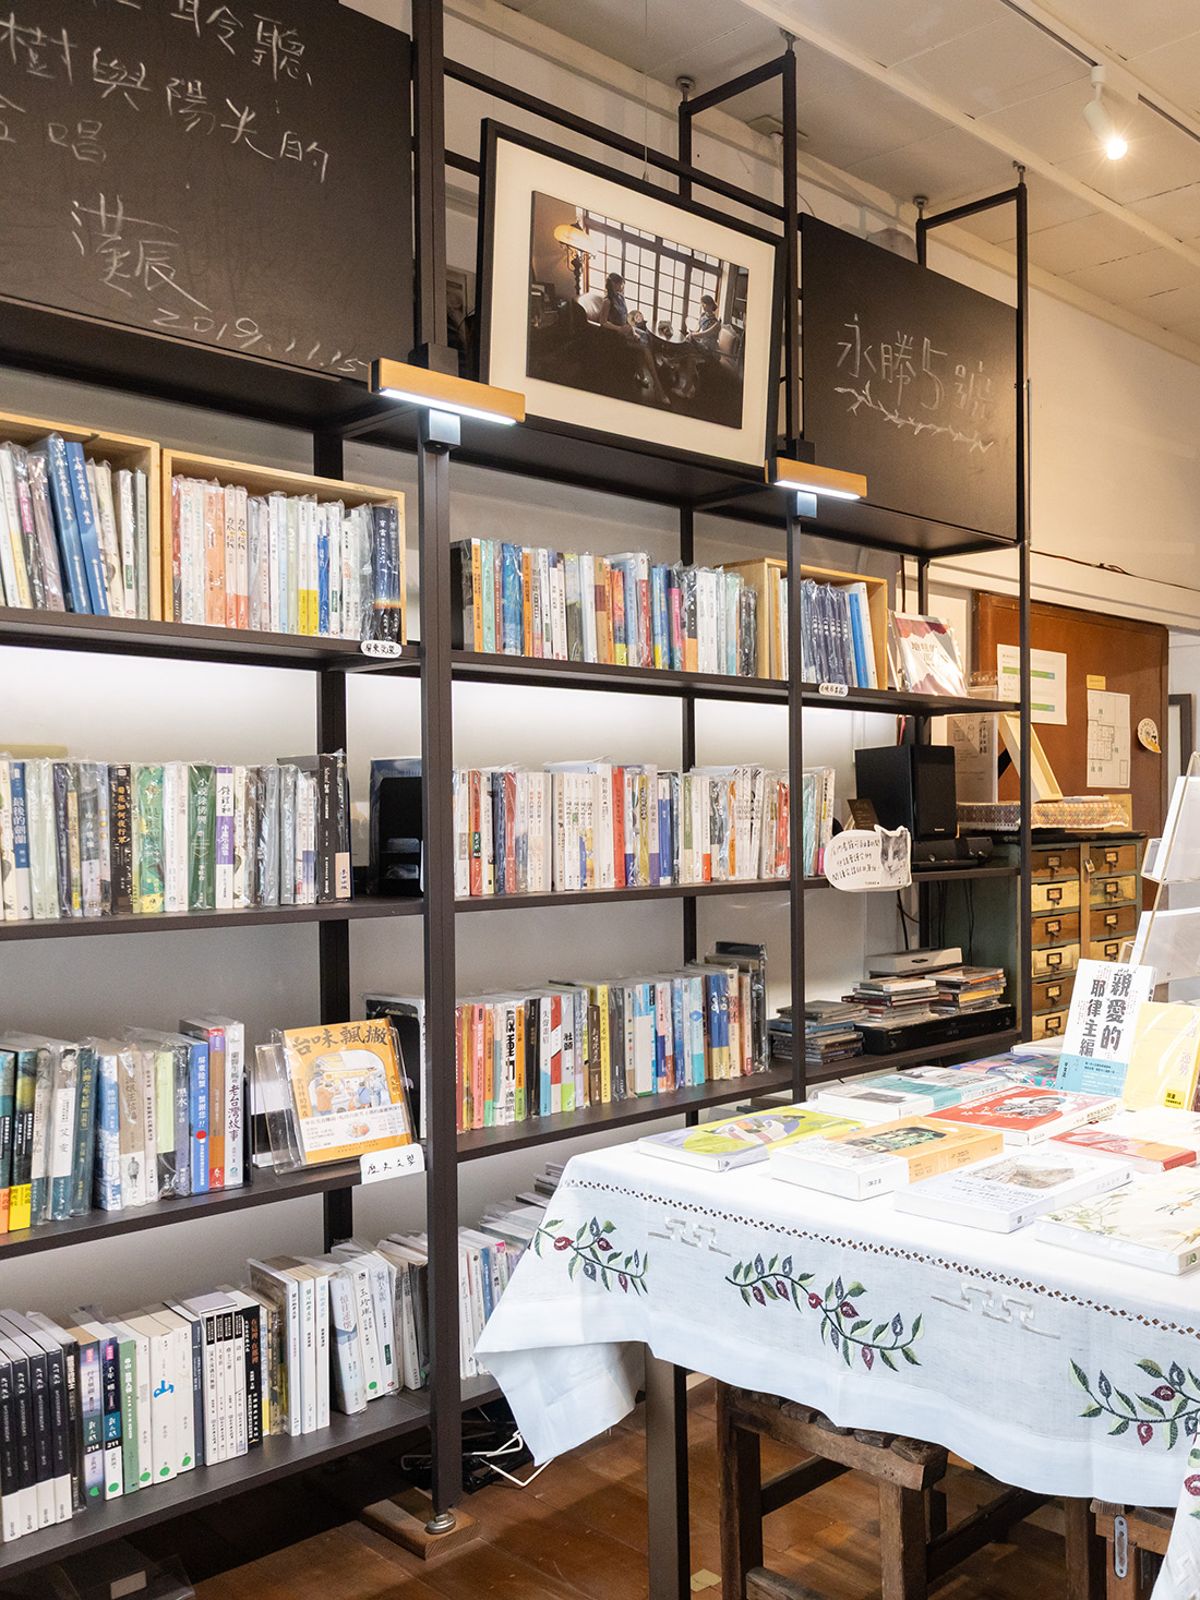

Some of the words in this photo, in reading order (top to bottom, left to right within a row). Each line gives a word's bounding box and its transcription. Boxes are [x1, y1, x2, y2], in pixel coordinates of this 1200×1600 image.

[836, 313, 993, 419] 永勝5號
[1079, 979, 1106, 1057] 耶律主編
[1101, 972, 1132, 1051] 親愛的
